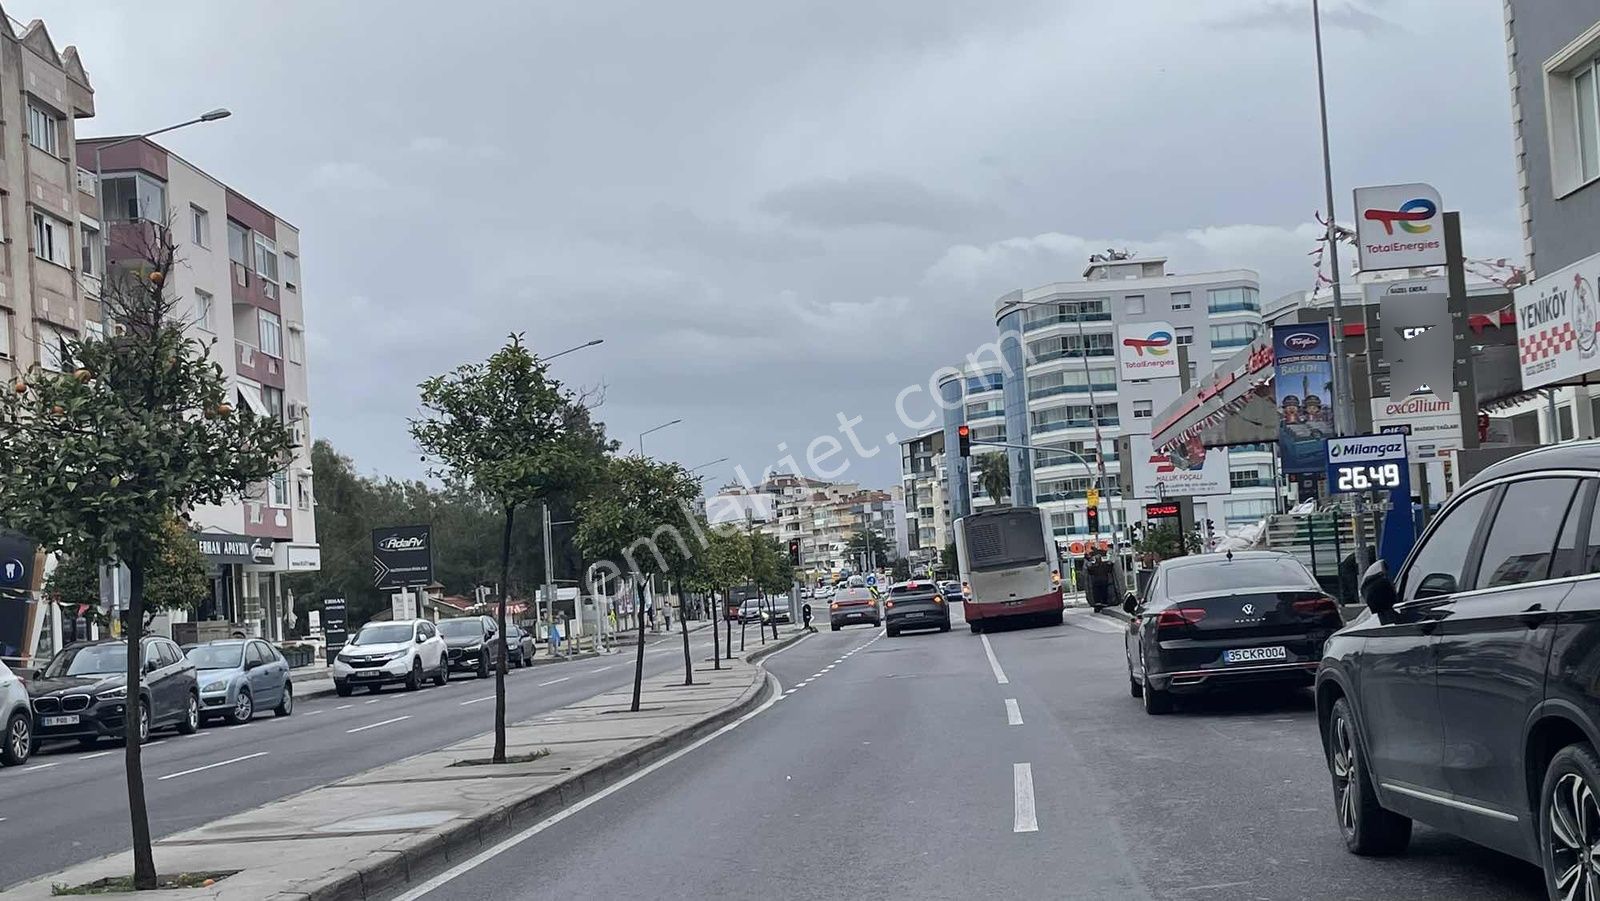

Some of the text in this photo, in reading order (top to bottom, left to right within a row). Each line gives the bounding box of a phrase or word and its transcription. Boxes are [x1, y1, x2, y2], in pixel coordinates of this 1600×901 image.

[1366, 241, 1439, 253] TotalEnergies
[1519, 286, 1567, 330] YENİKÖY
[1125, 360, 1175, 368] TotalEnergies
[1386, 399, 1450, 414] excellium
[1343, 443, 1402, 457] Milangaz
[1338, 463, 1400, 490] 26.49
